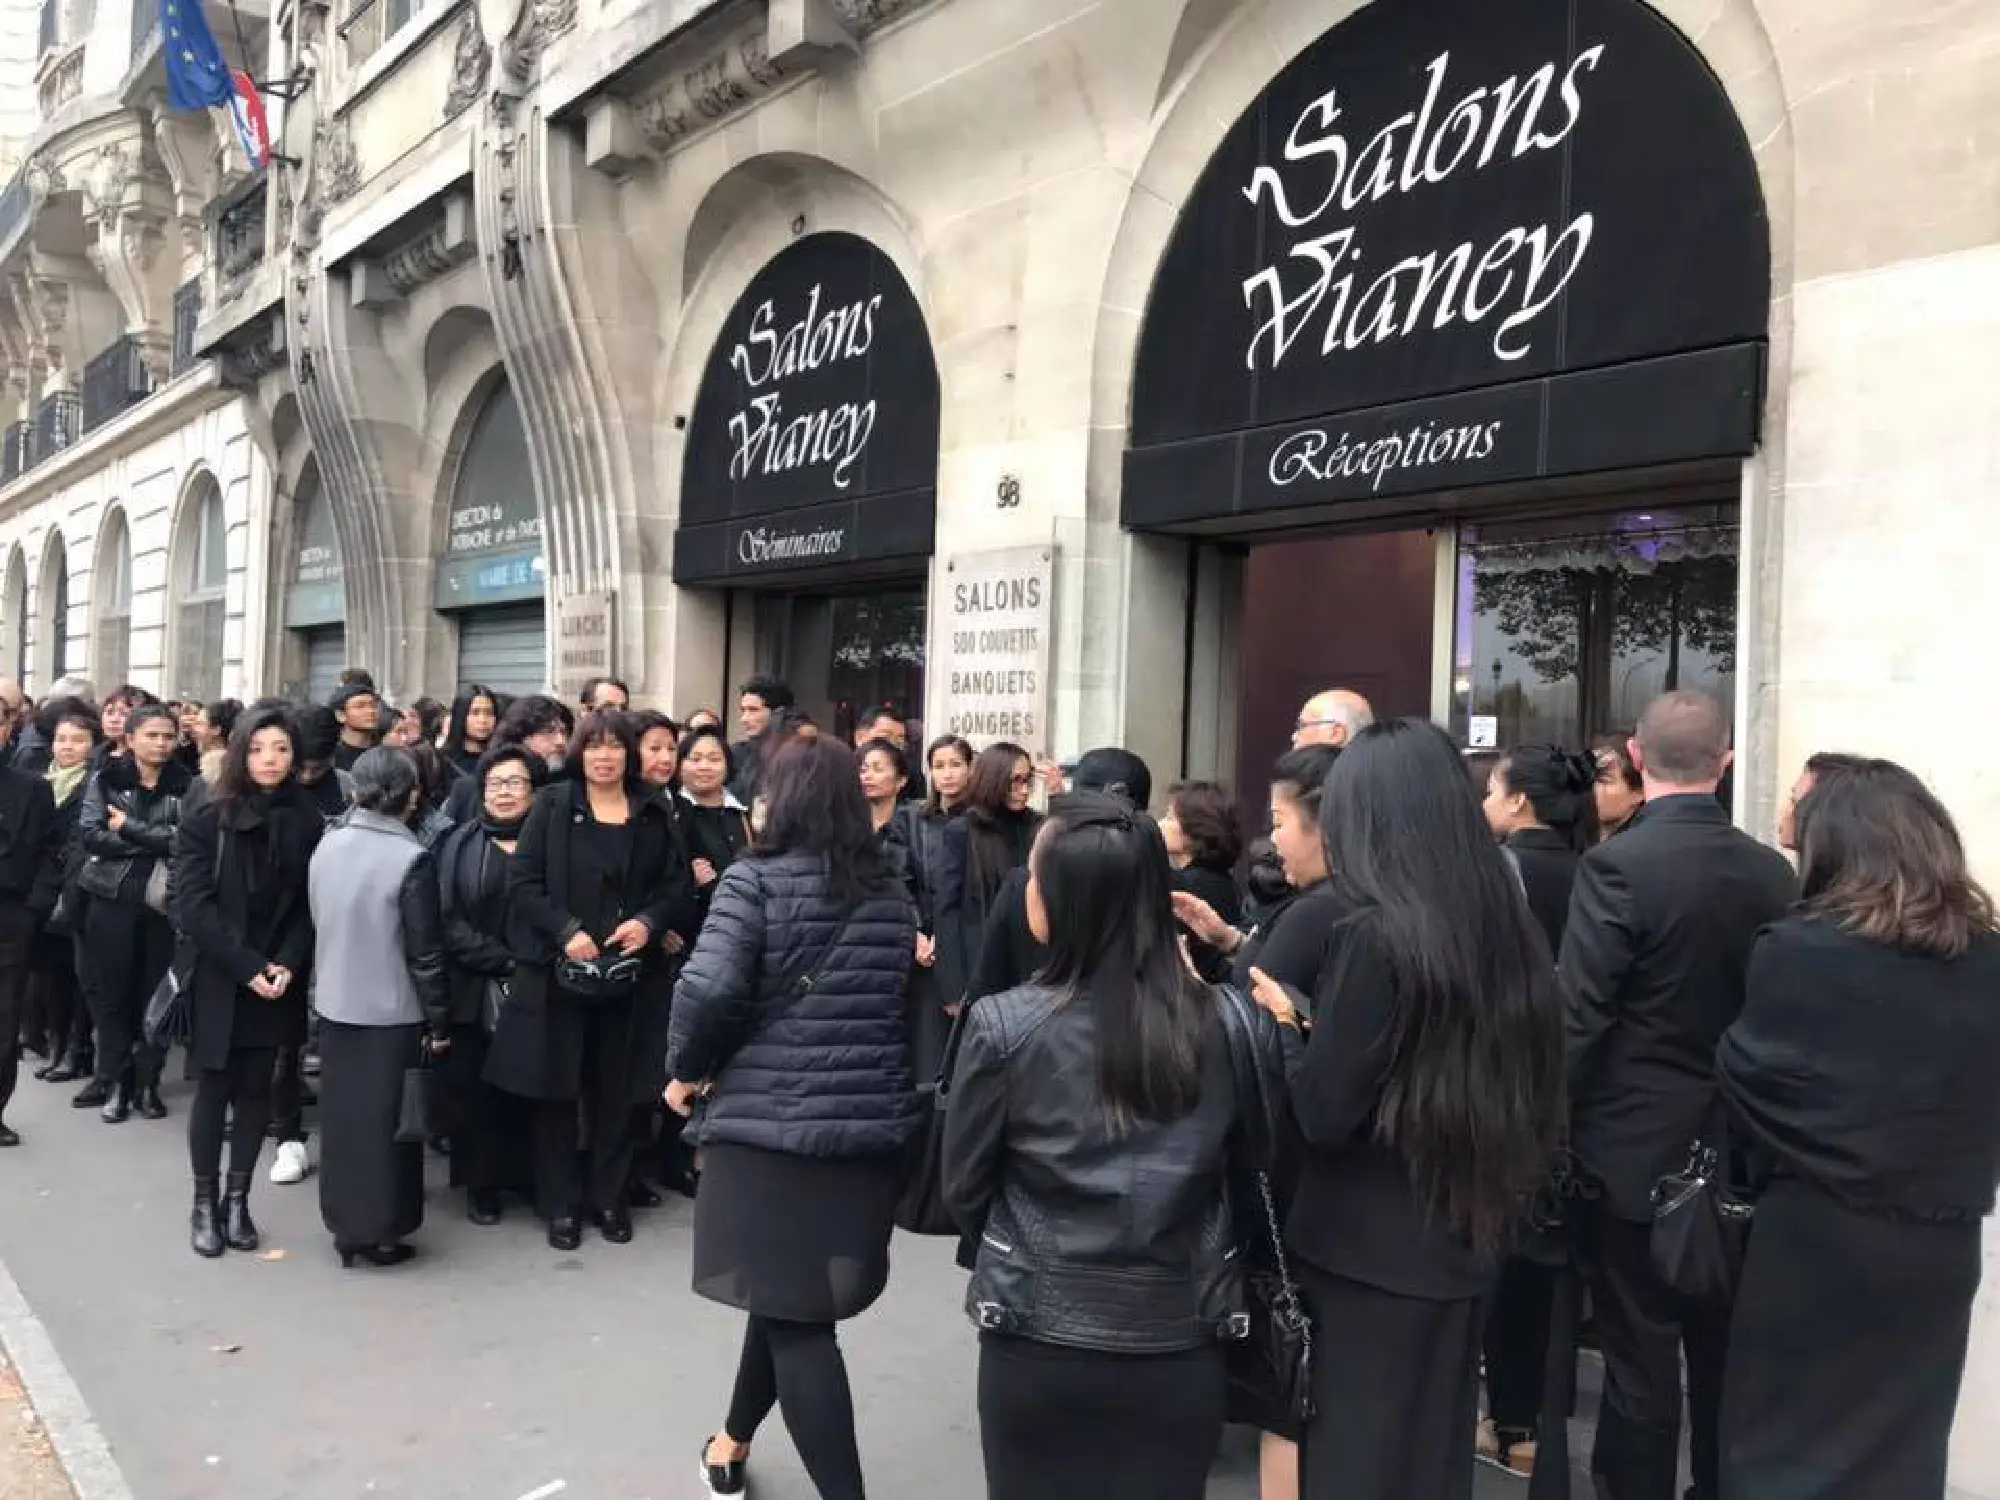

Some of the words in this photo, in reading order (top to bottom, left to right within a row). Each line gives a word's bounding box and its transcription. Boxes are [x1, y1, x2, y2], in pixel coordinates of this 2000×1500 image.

[1242, 43, 1605, 226] Salons
[1242, 211, 1595, 370] Vianey
[730, 283, 882, 386] Salons
[729, 391, 876, 488] Vianey
[1268, 419, 1502, 492] Réceptions
[997, 474, 1020, 508] 98
[954, 576, 1041, 614] SALONS
[951, 670, 1037, 696] BANQUETS
[949, 711, 1035, 736] CONGRES
